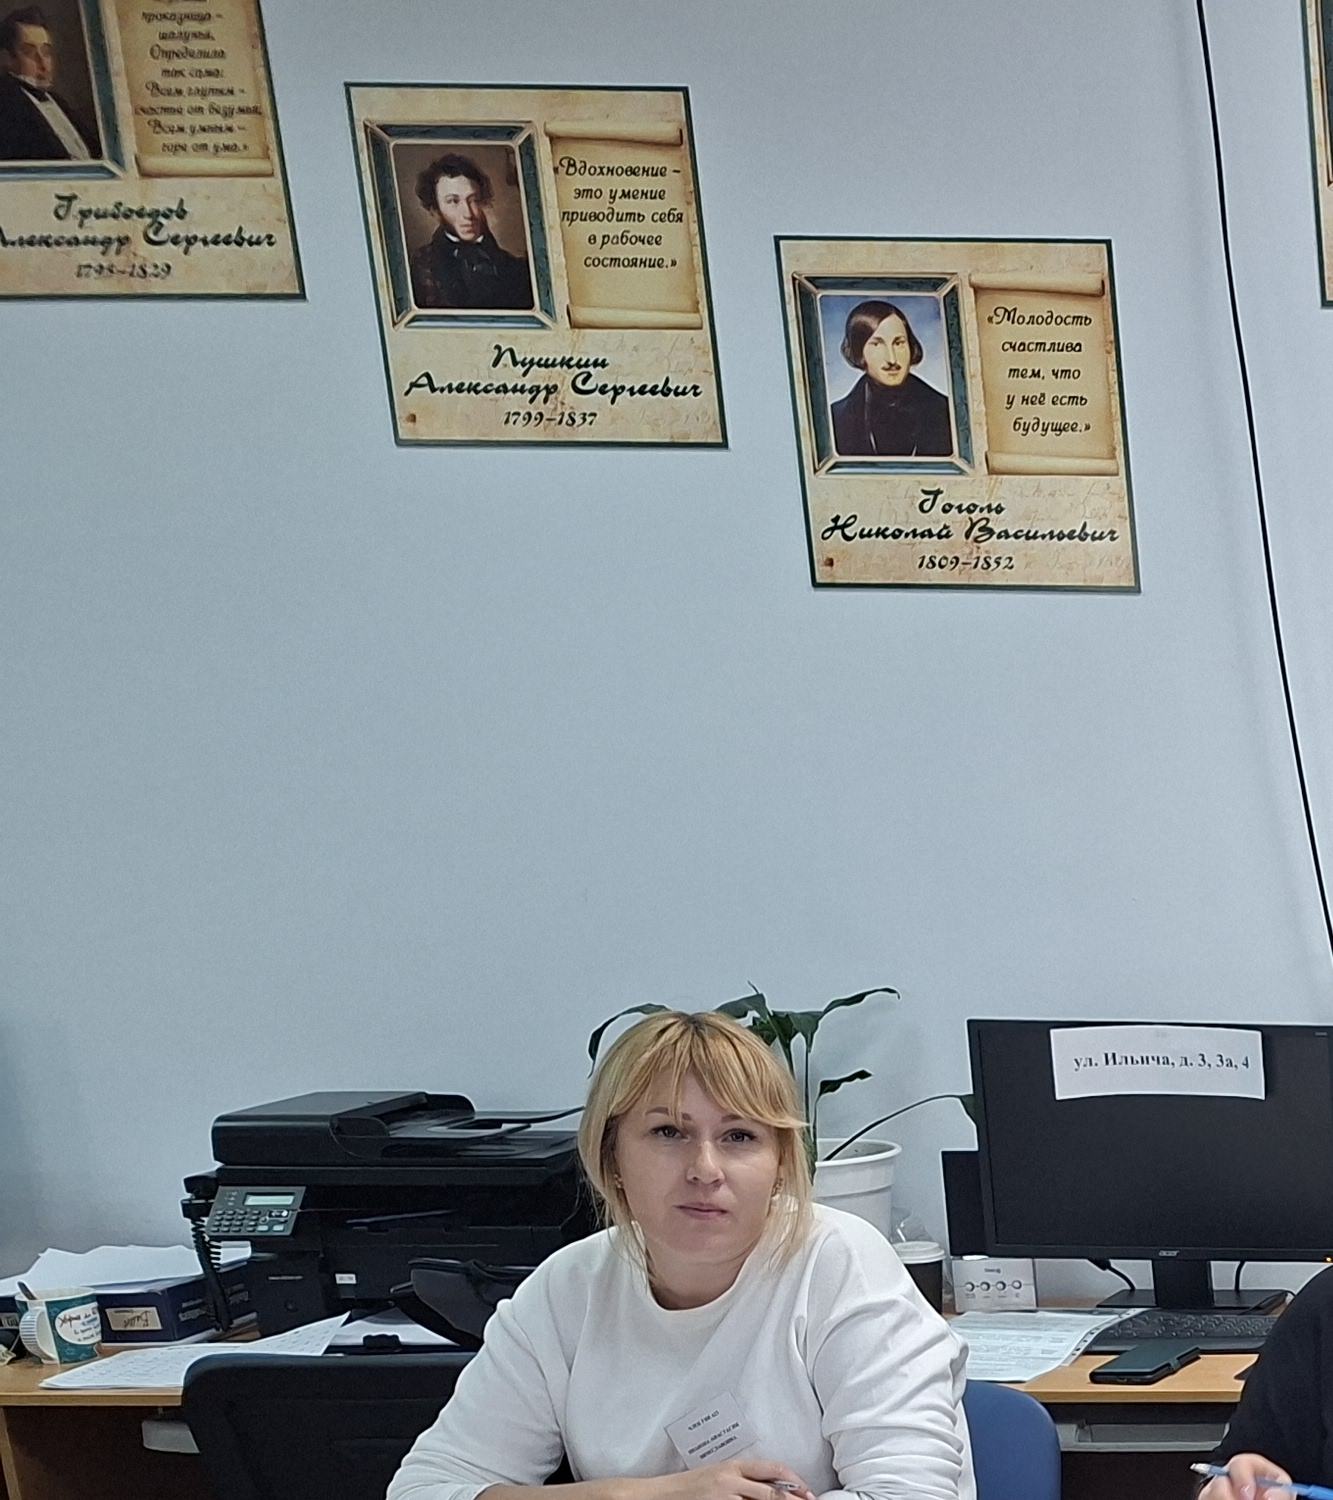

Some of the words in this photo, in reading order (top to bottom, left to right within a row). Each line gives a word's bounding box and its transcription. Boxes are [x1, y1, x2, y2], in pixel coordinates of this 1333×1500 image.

[554, 157, 667, 178] «Вдохновение
[573, 187, 602, 200] это
[609, 187, 666, 205] умение
[54, 193, 188, 225] Грибоедов
[562, 207, 646, 227] приводить
[651, 207, 684, 223] себя
[142, 221, 277, 255] Сергеевич
[588, 234, 596, 245] в
[600, 231, 663, 250] рабочее
[584, 254, 677, 269] состояние.»
[987, 307, 1092, 327] «Молодость
[1002, 340, 1082, 352] счастлива
[491, 345, 609, 377] Пушкин
[1008, 367, 1045, 381] тем,
[1051, 368, 1081, 380] что
[404, 372, 558, 404] Александр
[571, 371, 702, 404] Сергеевич
[1006, 395, 1015, 409] у
[1021, 392, 1046, 406] неё
[1052, 394, 1088, 406] есть
[503, 410, 598, 427] 1799-1837
[1013, 418, 1091, 436] будущее.»
[918, 488, 1006, 514] Гоголь
[821, 515, 952, 542] Николай
[964, 517, 1119, 543] Васильевич
[918, 554, 1014, 571] 1809-1852
[1074, 1056, 1098, 1071] ул.
[1102, 1052, 1176, 1068] Ильича,
[1179, 1055, 1194, 1068] д.
[1198, 1054, 1211, 1069] 3,
[1216, 1054, 1239, 1070] 3а,
[1242, 1056, 1249, 1069] 4
